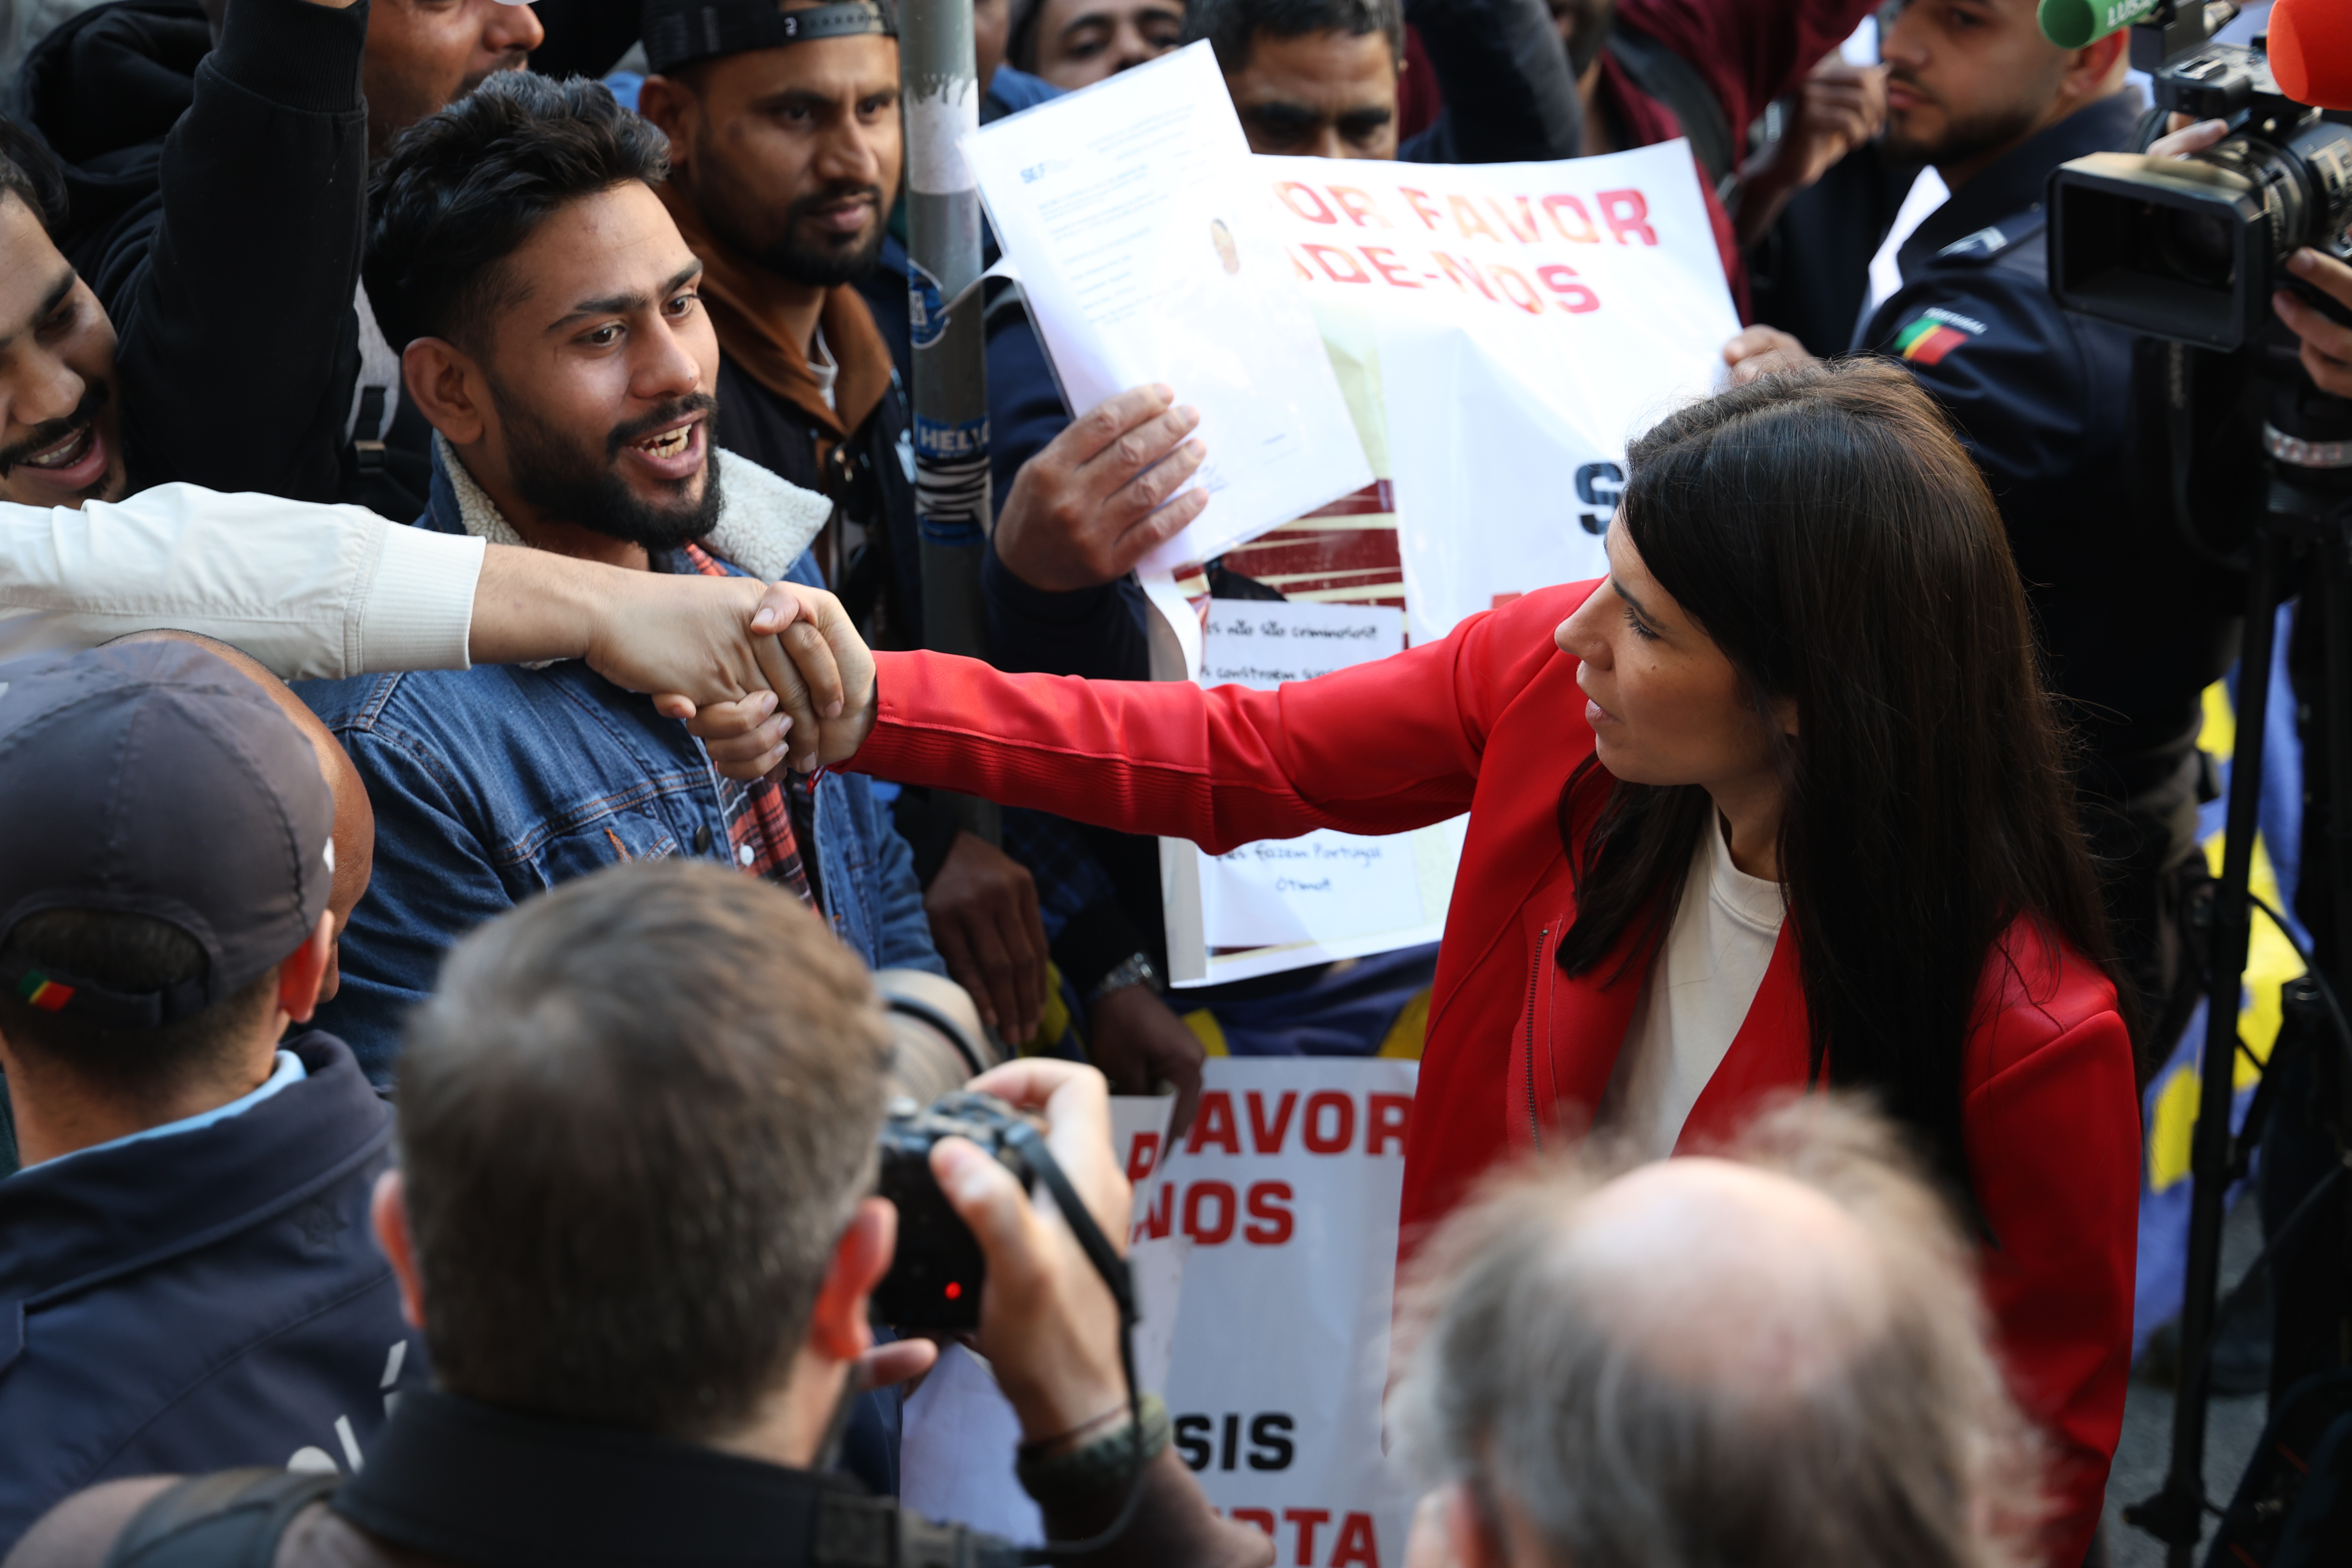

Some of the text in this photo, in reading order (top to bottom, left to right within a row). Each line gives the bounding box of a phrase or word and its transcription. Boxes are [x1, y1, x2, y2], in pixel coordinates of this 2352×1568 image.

[1270, 181, 1658, 246] OR FAVOR
[1185, 1090, 1414, 1157] AVOR
